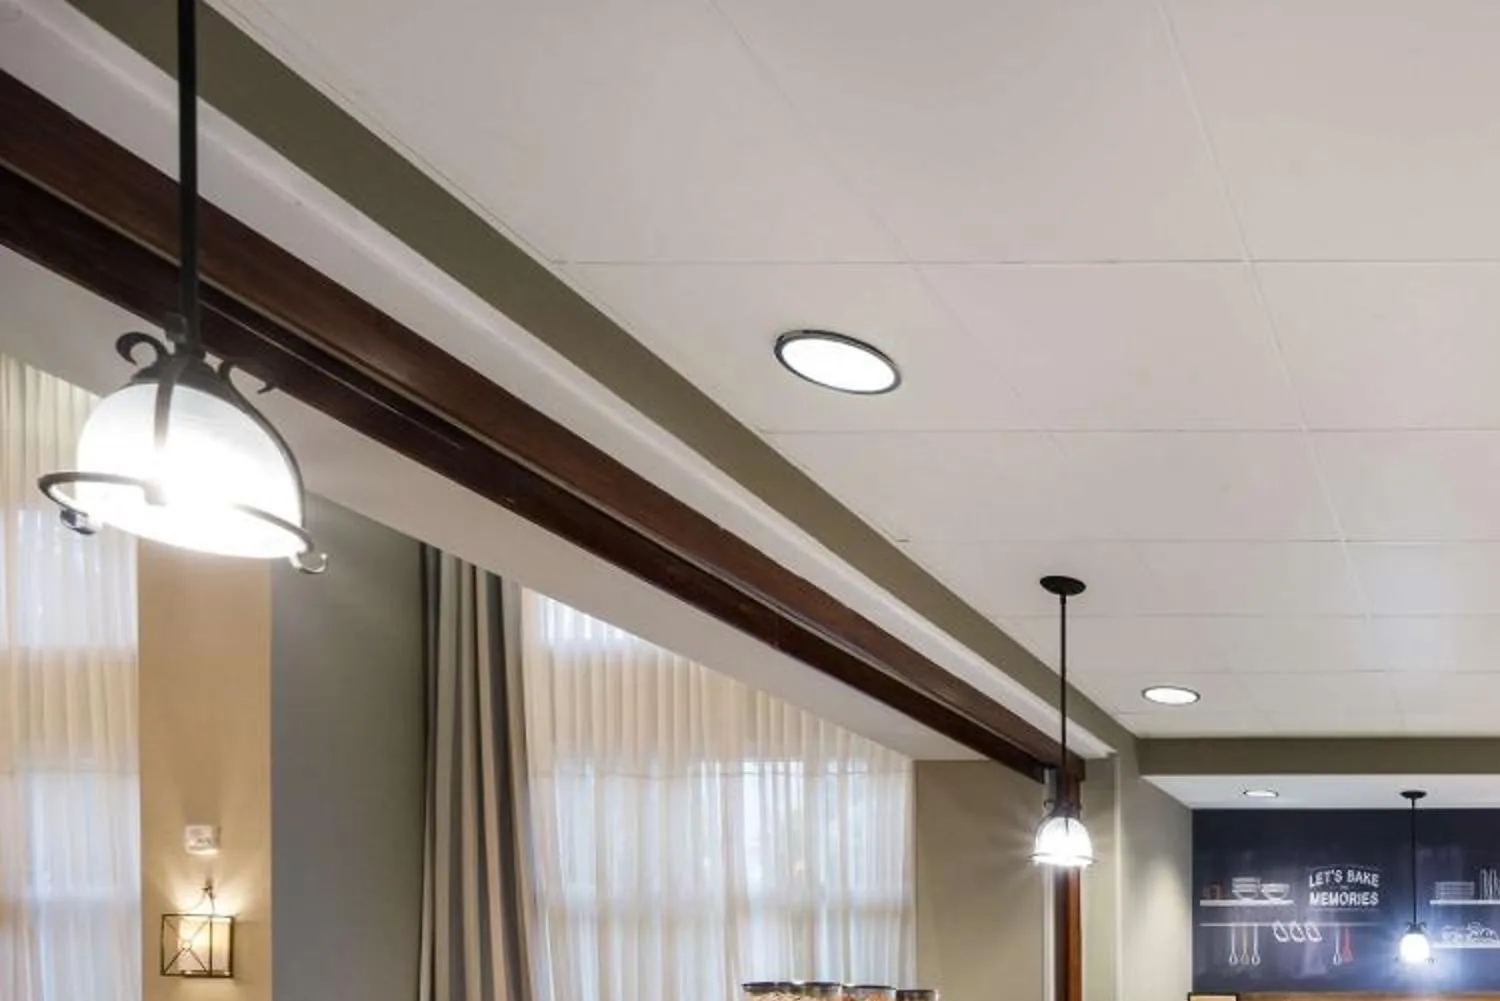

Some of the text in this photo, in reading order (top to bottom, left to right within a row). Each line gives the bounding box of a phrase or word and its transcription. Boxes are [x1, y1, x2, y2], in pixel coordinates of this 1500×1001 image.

[1309, 869, 1379, 888] LET'S BAKE
[1309, 891, 1379, 907] MEMORIES
